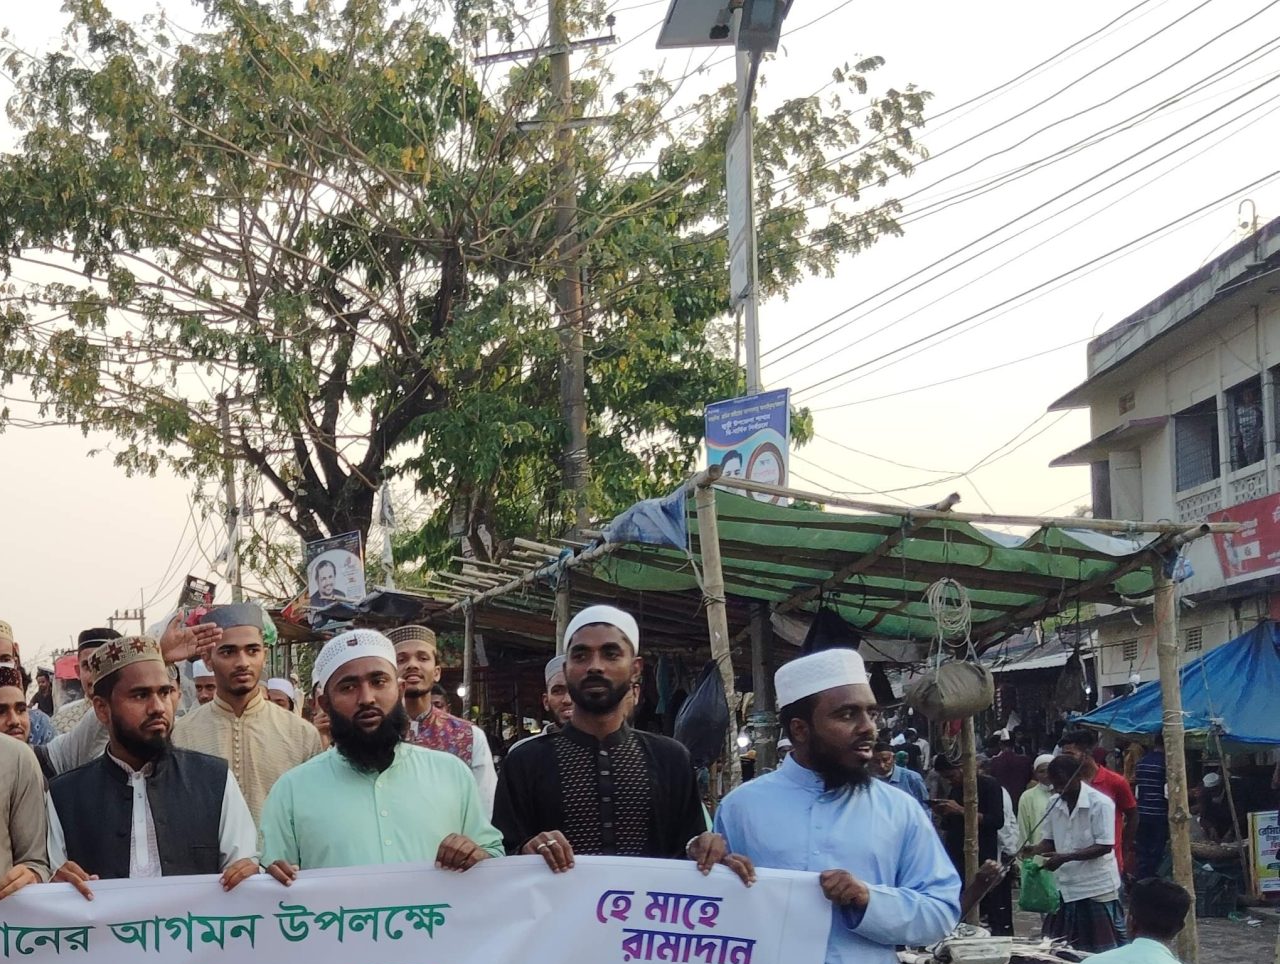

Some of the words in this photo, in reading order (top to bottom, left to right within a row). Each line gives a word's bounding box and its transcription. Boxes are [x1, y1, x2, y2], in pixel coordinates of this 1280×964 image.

[107, 910, 264, 953] আগমন
[273, 900, 452, 945] উপলক্ষে
[596, 889, 635, 924] হে
[646, 890, 723, 930] মাহে
